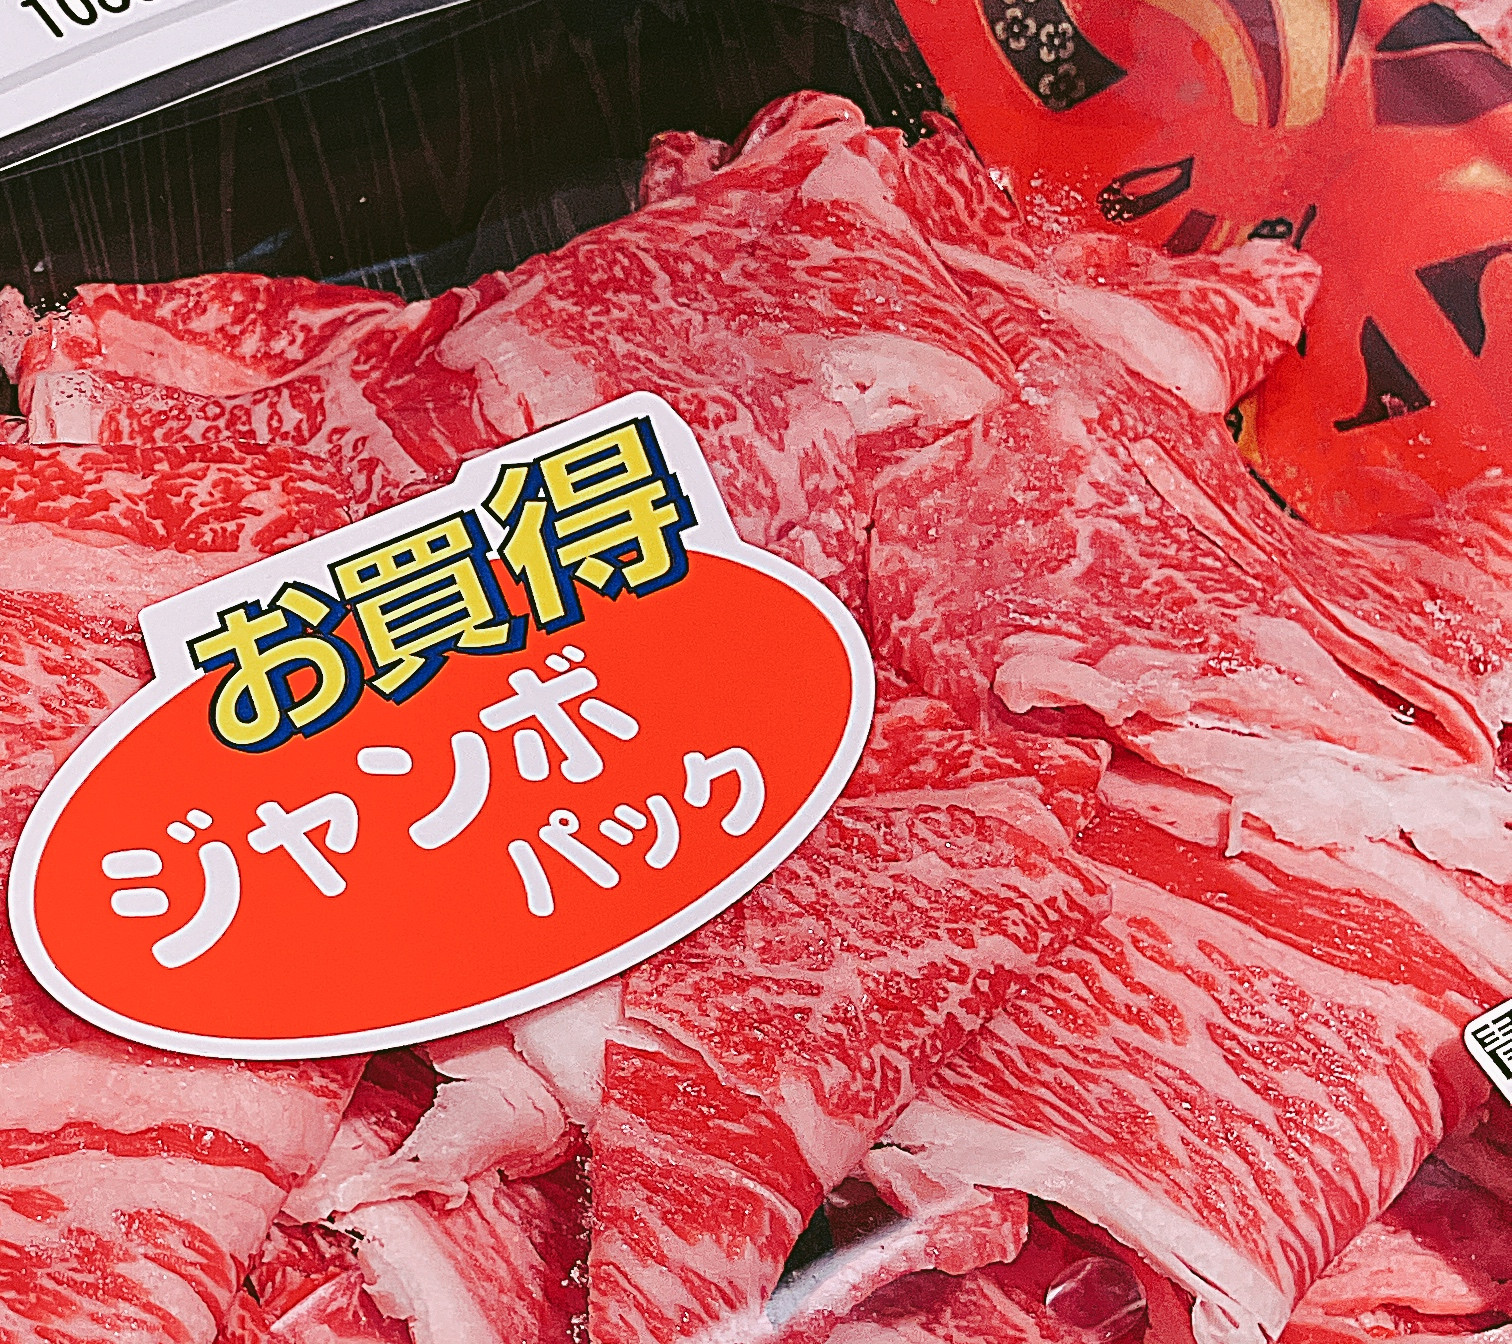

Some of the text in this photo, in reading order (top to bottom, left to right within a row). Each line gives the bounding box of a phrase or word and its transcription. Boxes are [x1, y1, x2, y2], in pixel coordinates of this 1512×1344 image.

[188, 416, 697, 751] お買得
[102, 645, 639, 969] ジャンボ
[508, 746, 767, 917] パック
